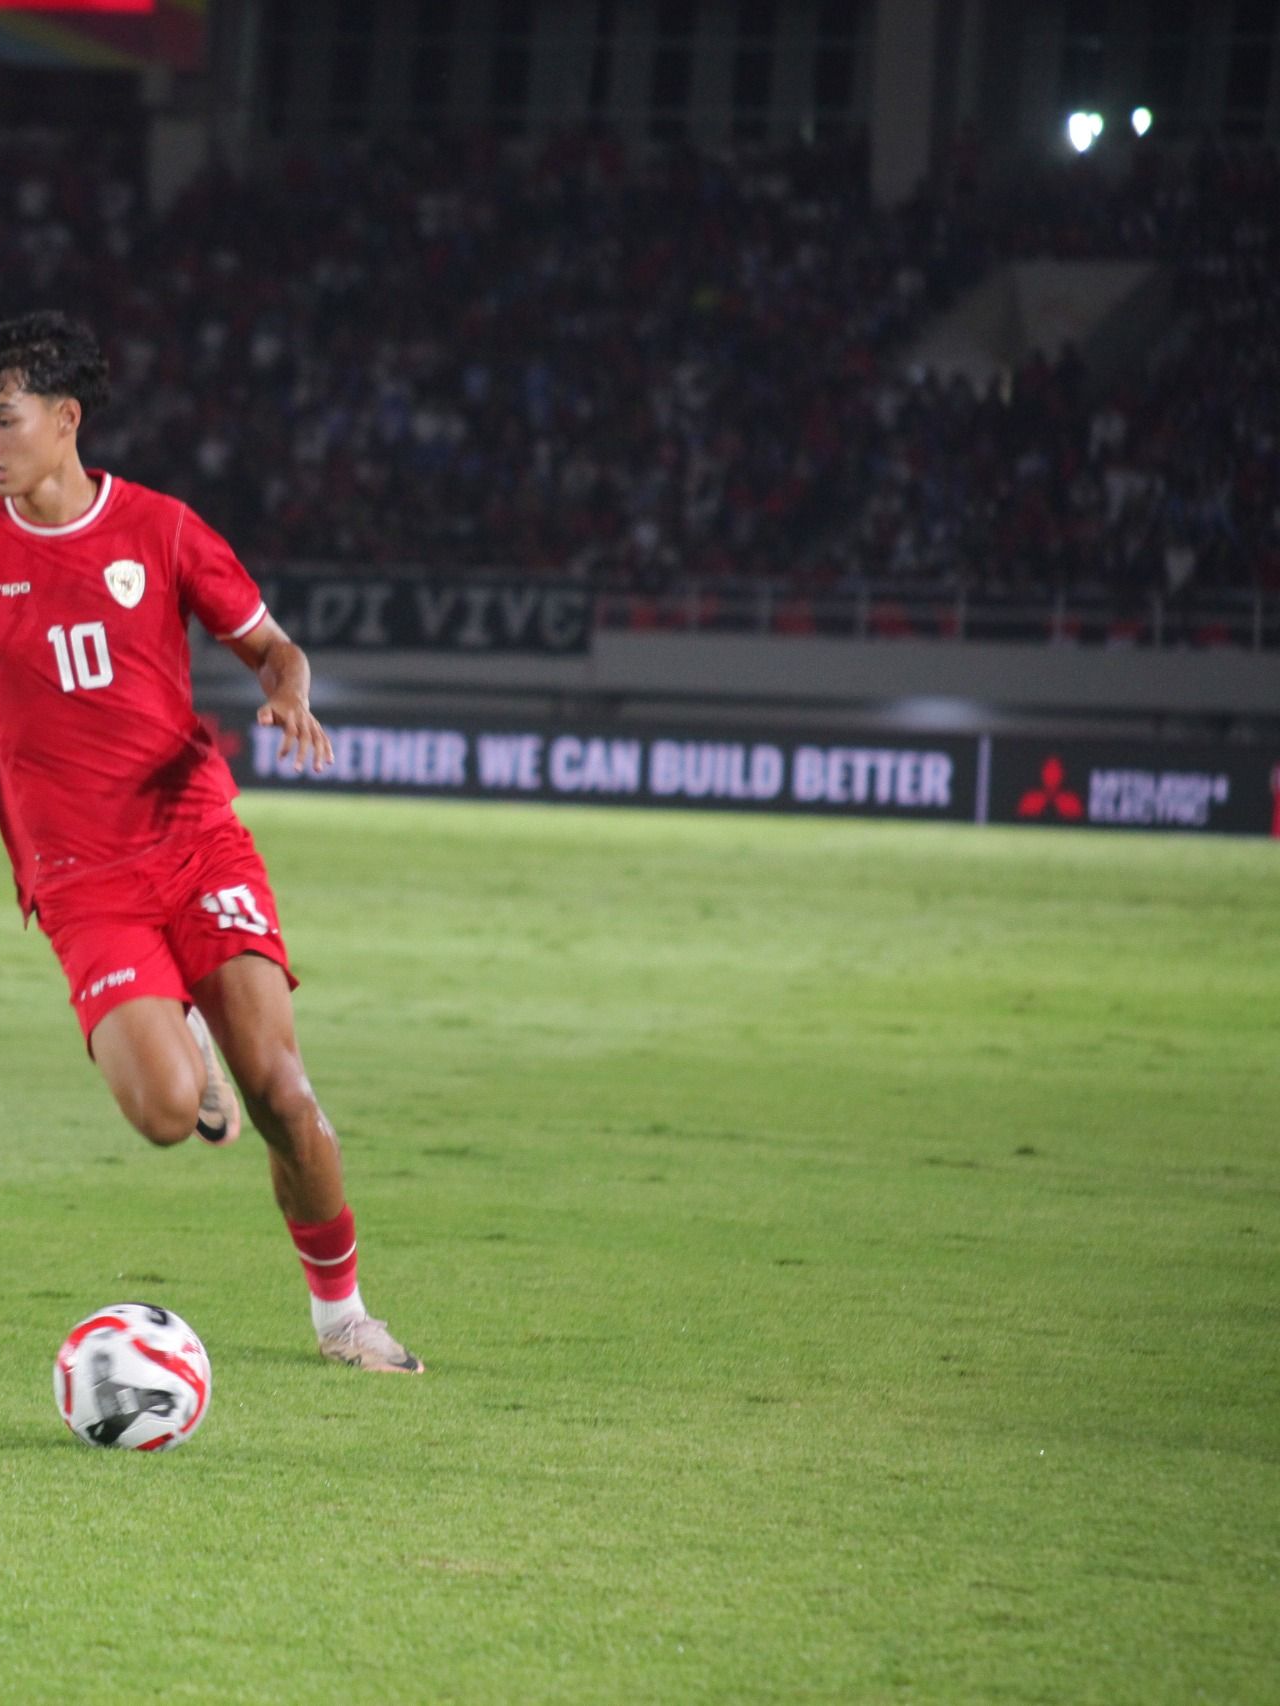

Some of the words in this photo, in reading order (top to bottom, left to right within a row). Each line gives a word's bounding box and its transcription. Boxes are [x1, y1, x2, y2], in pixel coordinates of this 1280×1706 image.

[47, 621, 114, 693] 10
[477, 732, 542, 790] WE
[548, 736, 642, 793] CAN
[649, 739, 784, 799] BUILD
[792, 746, 952, 807] BETTER
[201, 884, 269, 936] 10
